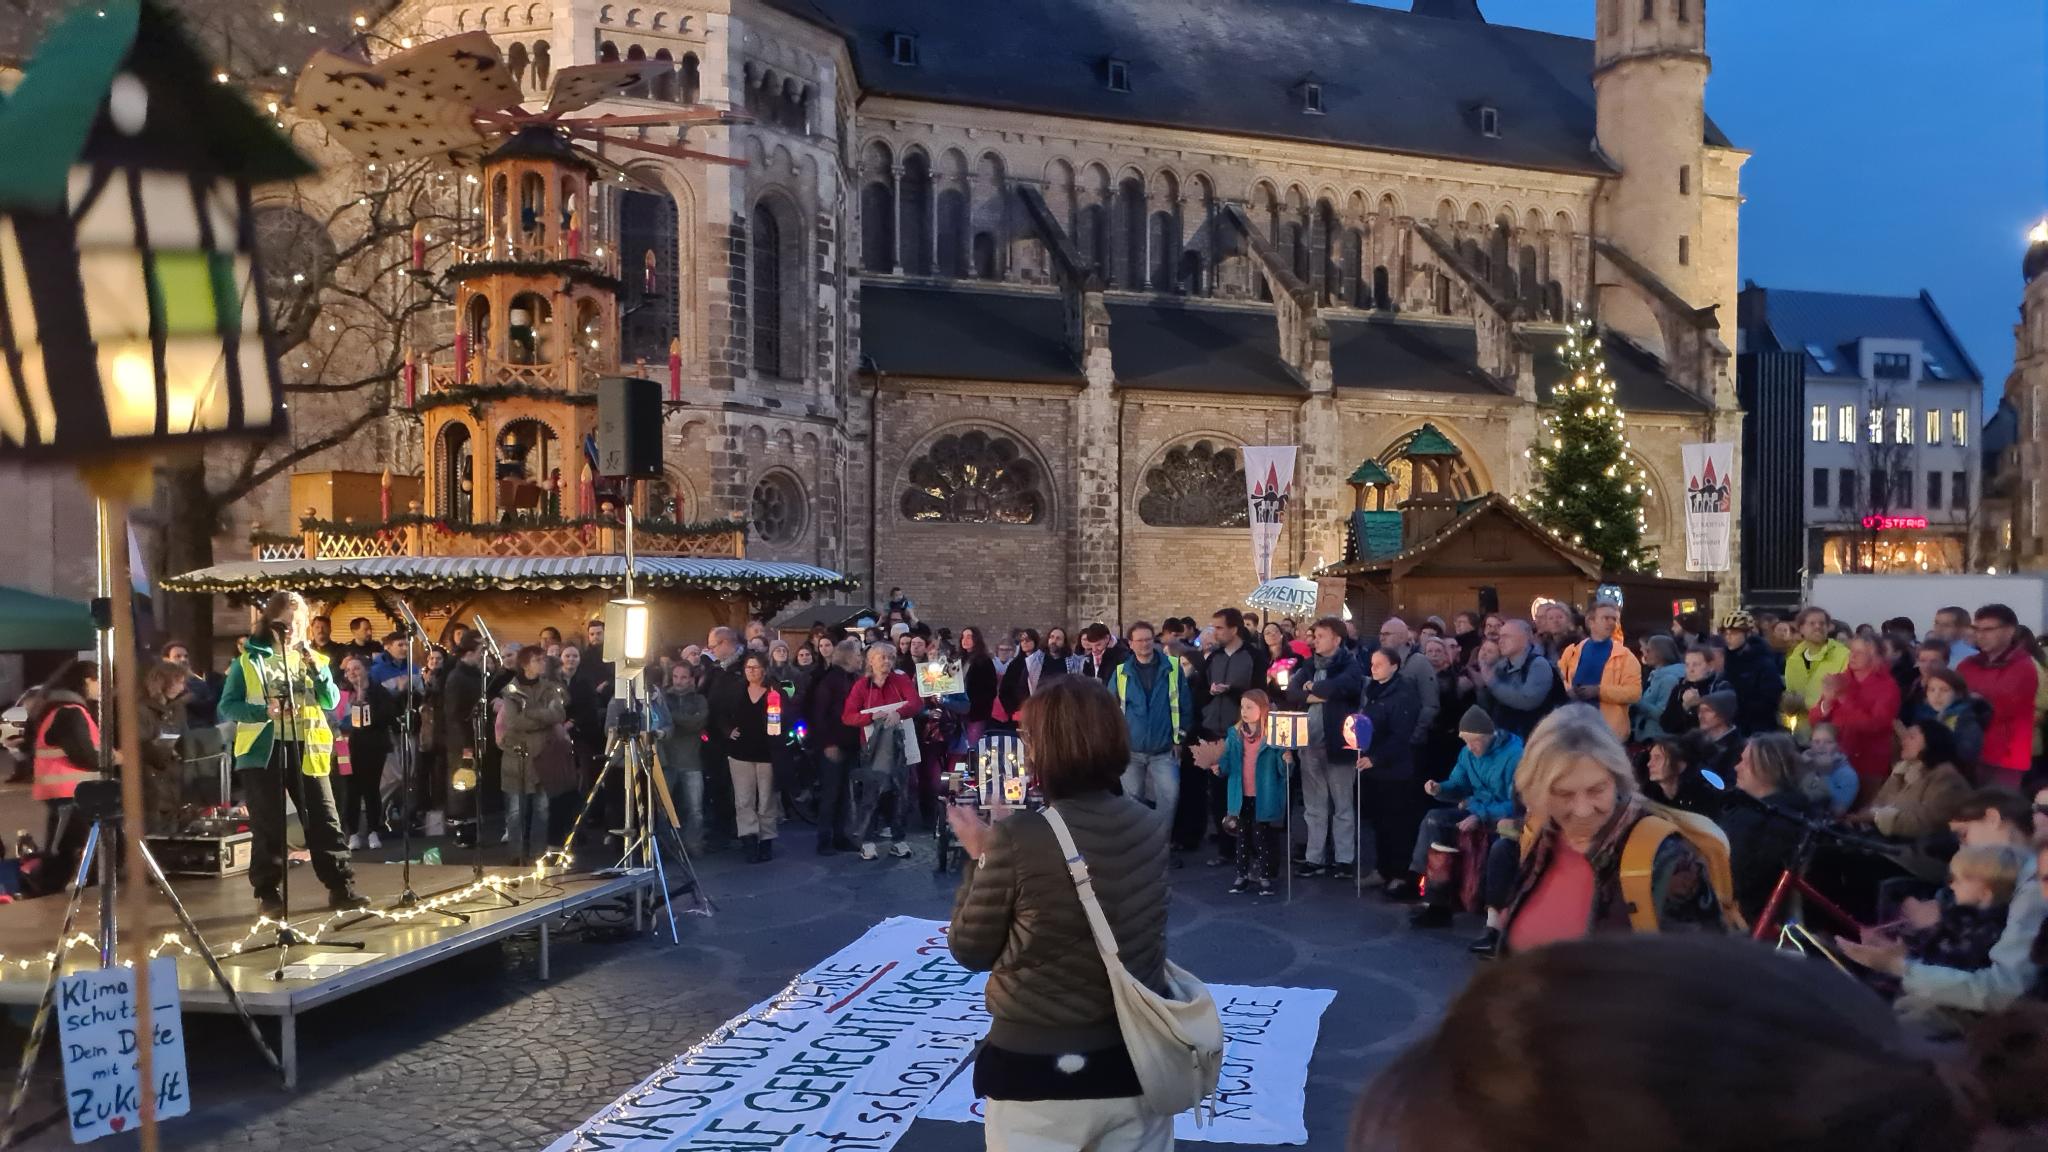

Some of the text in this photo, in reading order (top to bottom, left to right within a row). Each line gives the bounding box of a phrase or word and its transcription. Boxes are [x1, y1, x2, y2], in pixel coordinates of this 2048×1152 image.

[1252, 585, 1315, 605] PARENTS
[62, 979, 129, 1011] Klima
[69, 1044, 108, 1064] Dein
[118, 1024, 175, 1055] Dte
[92, 1063, 119, 1081] mit
